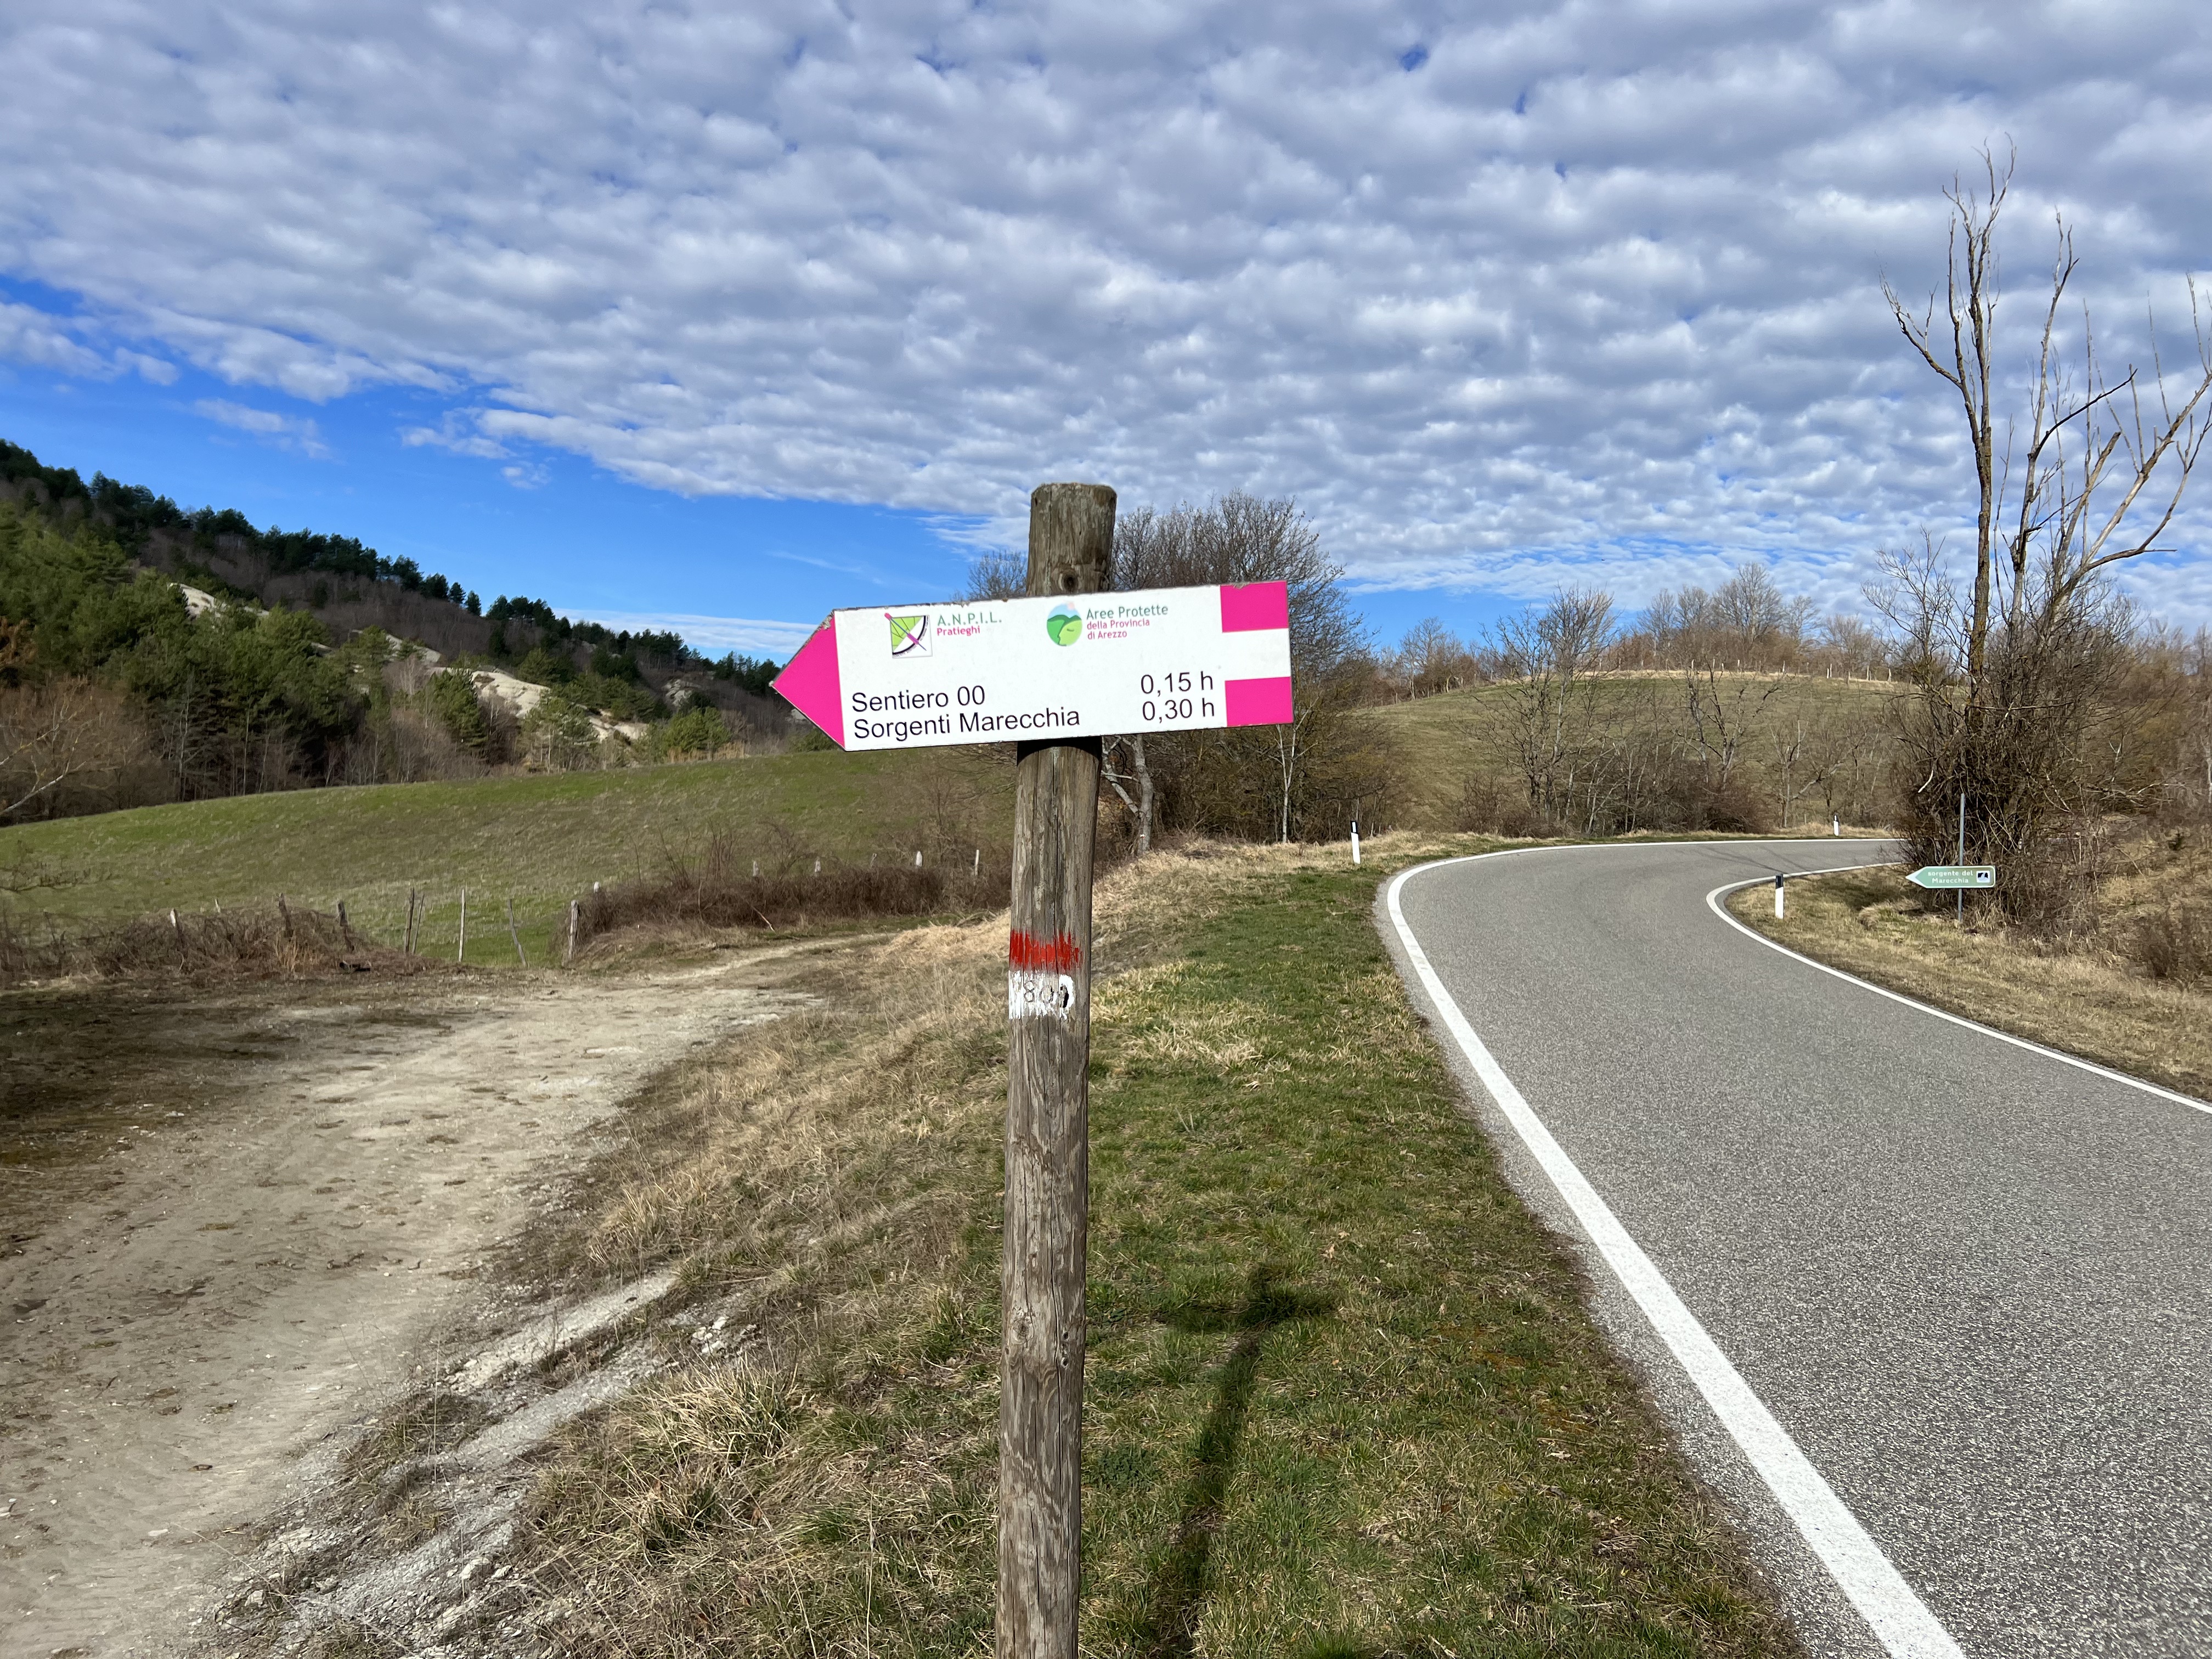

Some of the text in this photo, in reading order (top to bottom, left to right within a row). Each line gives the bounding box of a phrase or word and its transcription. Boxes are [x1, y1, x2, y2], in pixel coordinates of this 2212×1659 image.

[937, 612, 1002, 626] A.N.P.I.L.
[1086, 605, 1169, 620] Aree Protette
[936, 625, 980, 636] Pratieghi
[1086, 618, 1150, 630] della Provincia
[1087, 630, 1127, 640] di Arezzo
[1140, 670, 1213, 697] 0,15 h
[851, 685, 986, 713] Sentiero 00
[1142, 697, 1215, 724] 0,30 h
[854, 706, 1081, 742] Sorgenti Marecchia
